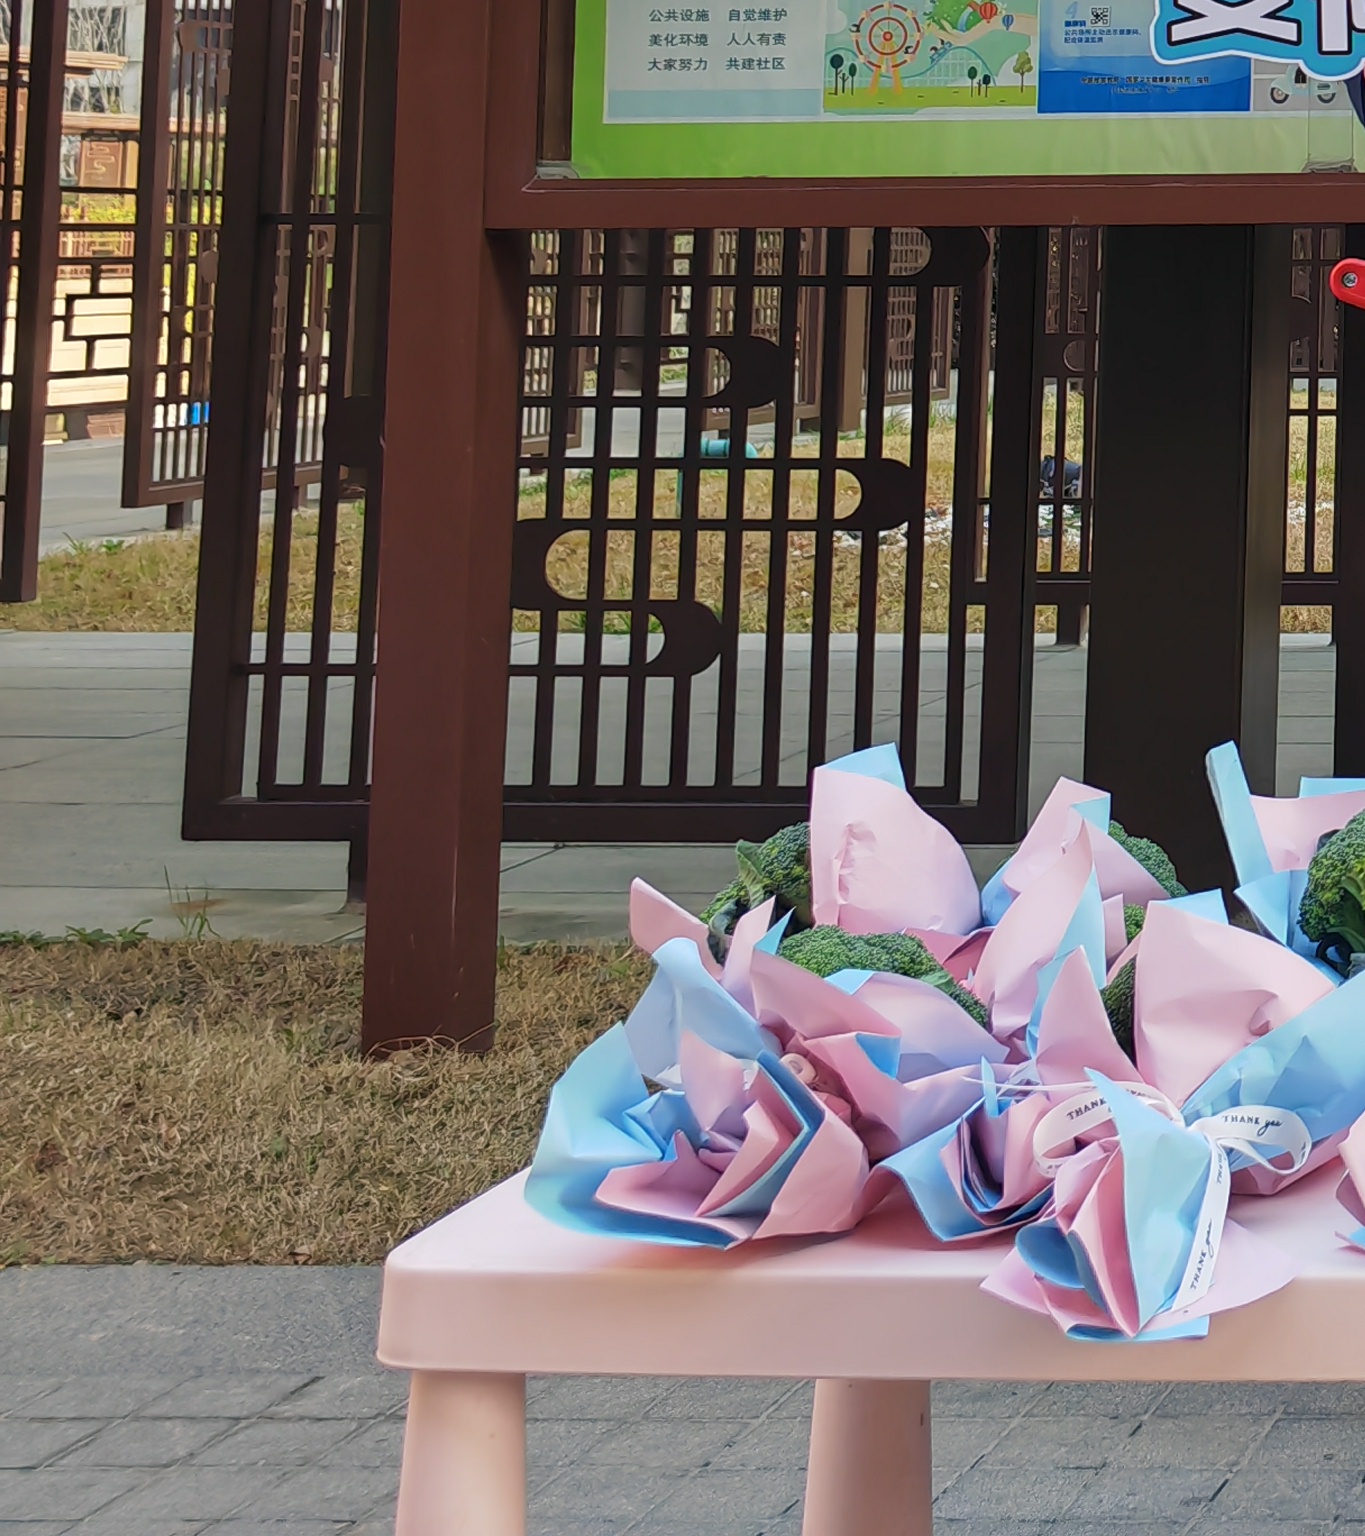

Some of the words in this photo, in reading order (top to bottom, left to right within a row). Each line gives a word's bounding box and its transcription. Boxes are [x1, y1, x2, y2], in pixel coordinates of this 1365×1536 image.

[649, 9, 710, 23] 公共设施
[728, 8, 788, 22] 自觉维护
[648, 33, 709, 47] 美化环境
[727, 33, 787, 46] 人人有责
[648, 58, 708, 71] 大家努力
[725, 57, 786, 70] 共建社区
[1066, 1097, 1107, 1121] THANK
[1222, 1114, 1260, 1126] THANK
[1259, 1119, 1283, 1136] you
[1190, 1250, 1207, 1291] THANK
[1204, 1218, 1215, 1259] you
